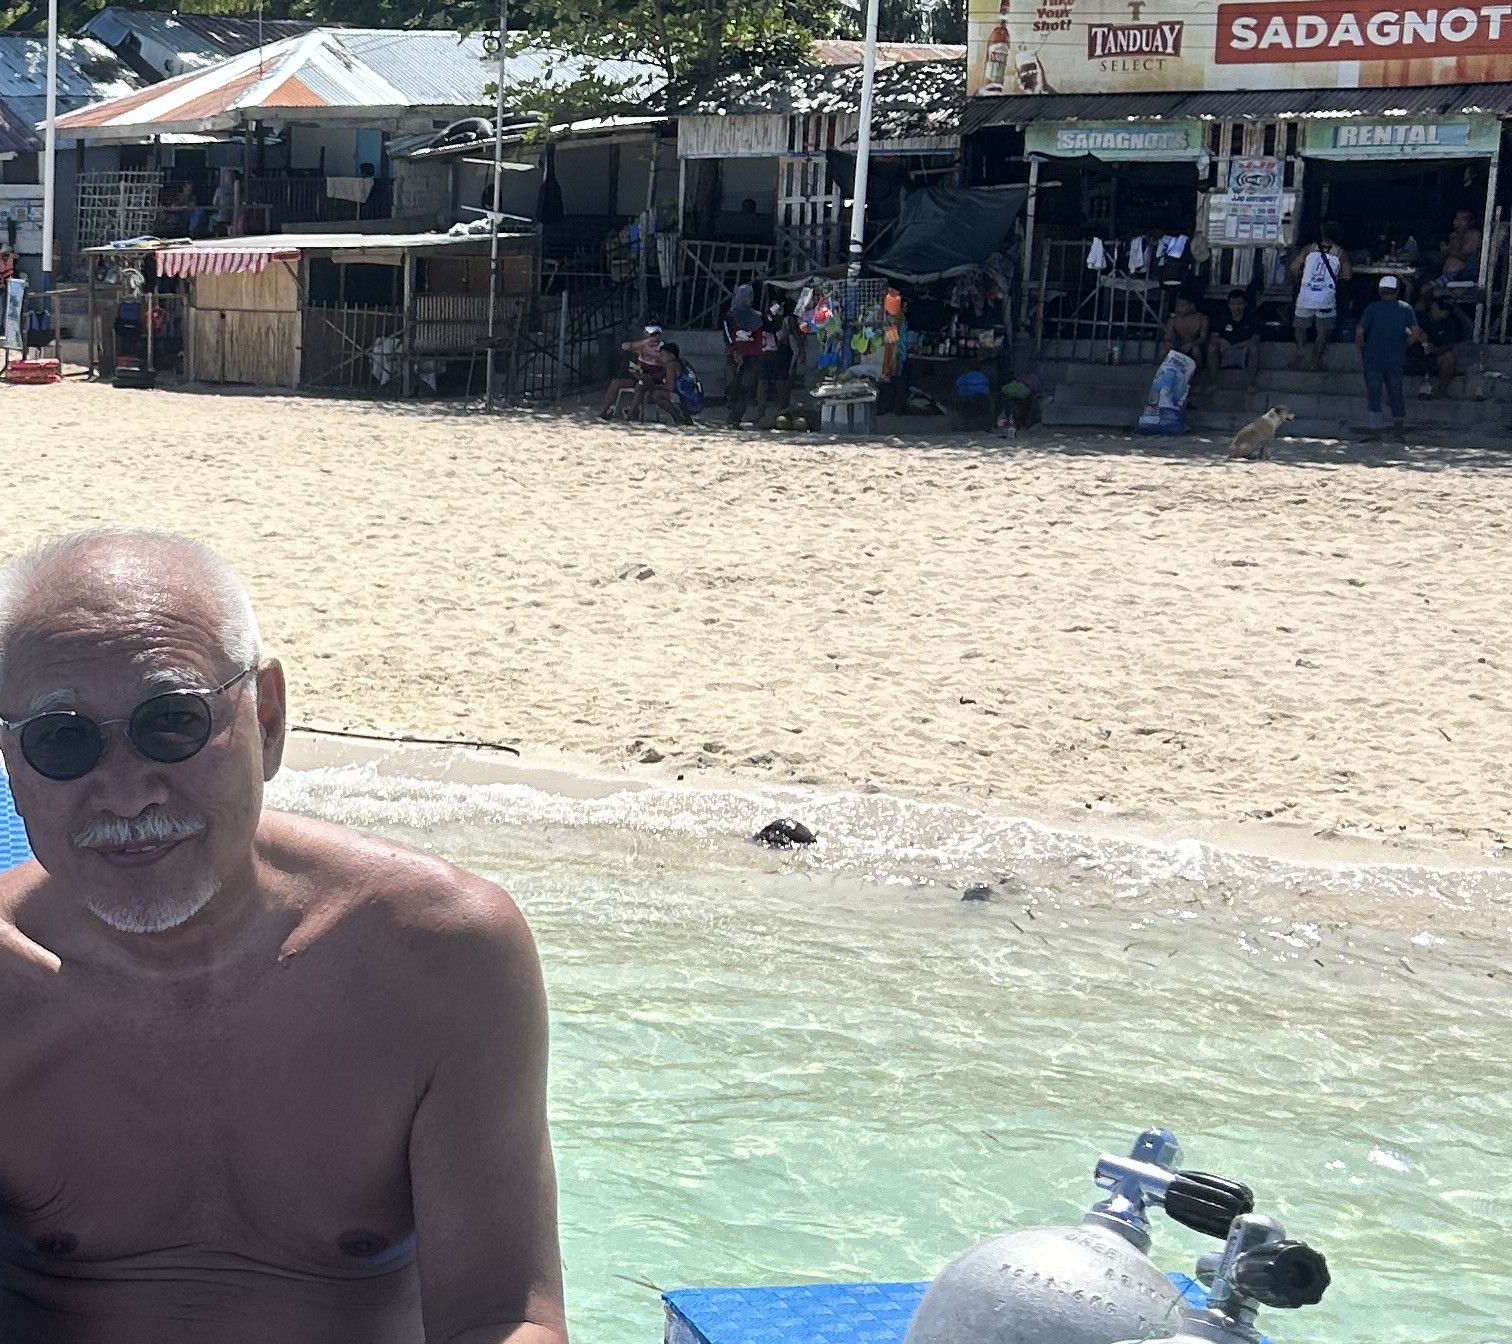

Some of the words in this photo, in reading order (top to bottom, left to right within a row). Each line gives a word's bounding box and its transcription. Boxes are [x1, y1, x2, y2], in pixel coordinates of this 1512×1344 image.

[1091, 24, 1181, 56] TANDUAY
[1099, 58, 1166, 72] SELECT
[1340, 125, 1439, 145] RENTAL
